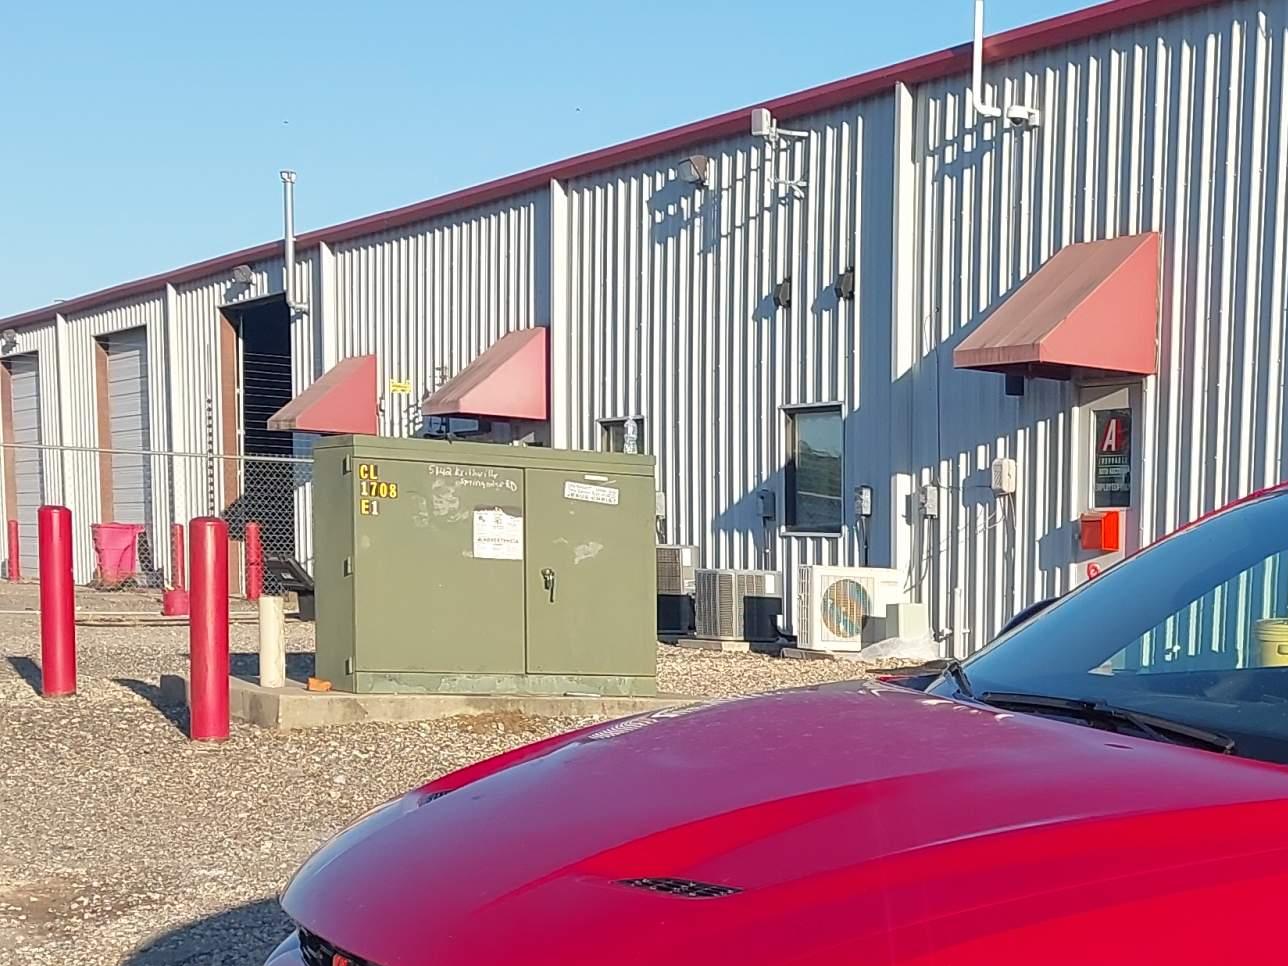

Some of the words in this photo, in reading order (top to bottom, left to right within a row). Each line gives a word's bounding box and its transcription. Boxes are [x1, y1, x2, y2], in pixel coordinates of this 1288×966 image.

[359, 464, 378, 480] CL
[360, 482, 398, 498] 1708
[360, 499, 379, 515] E1
